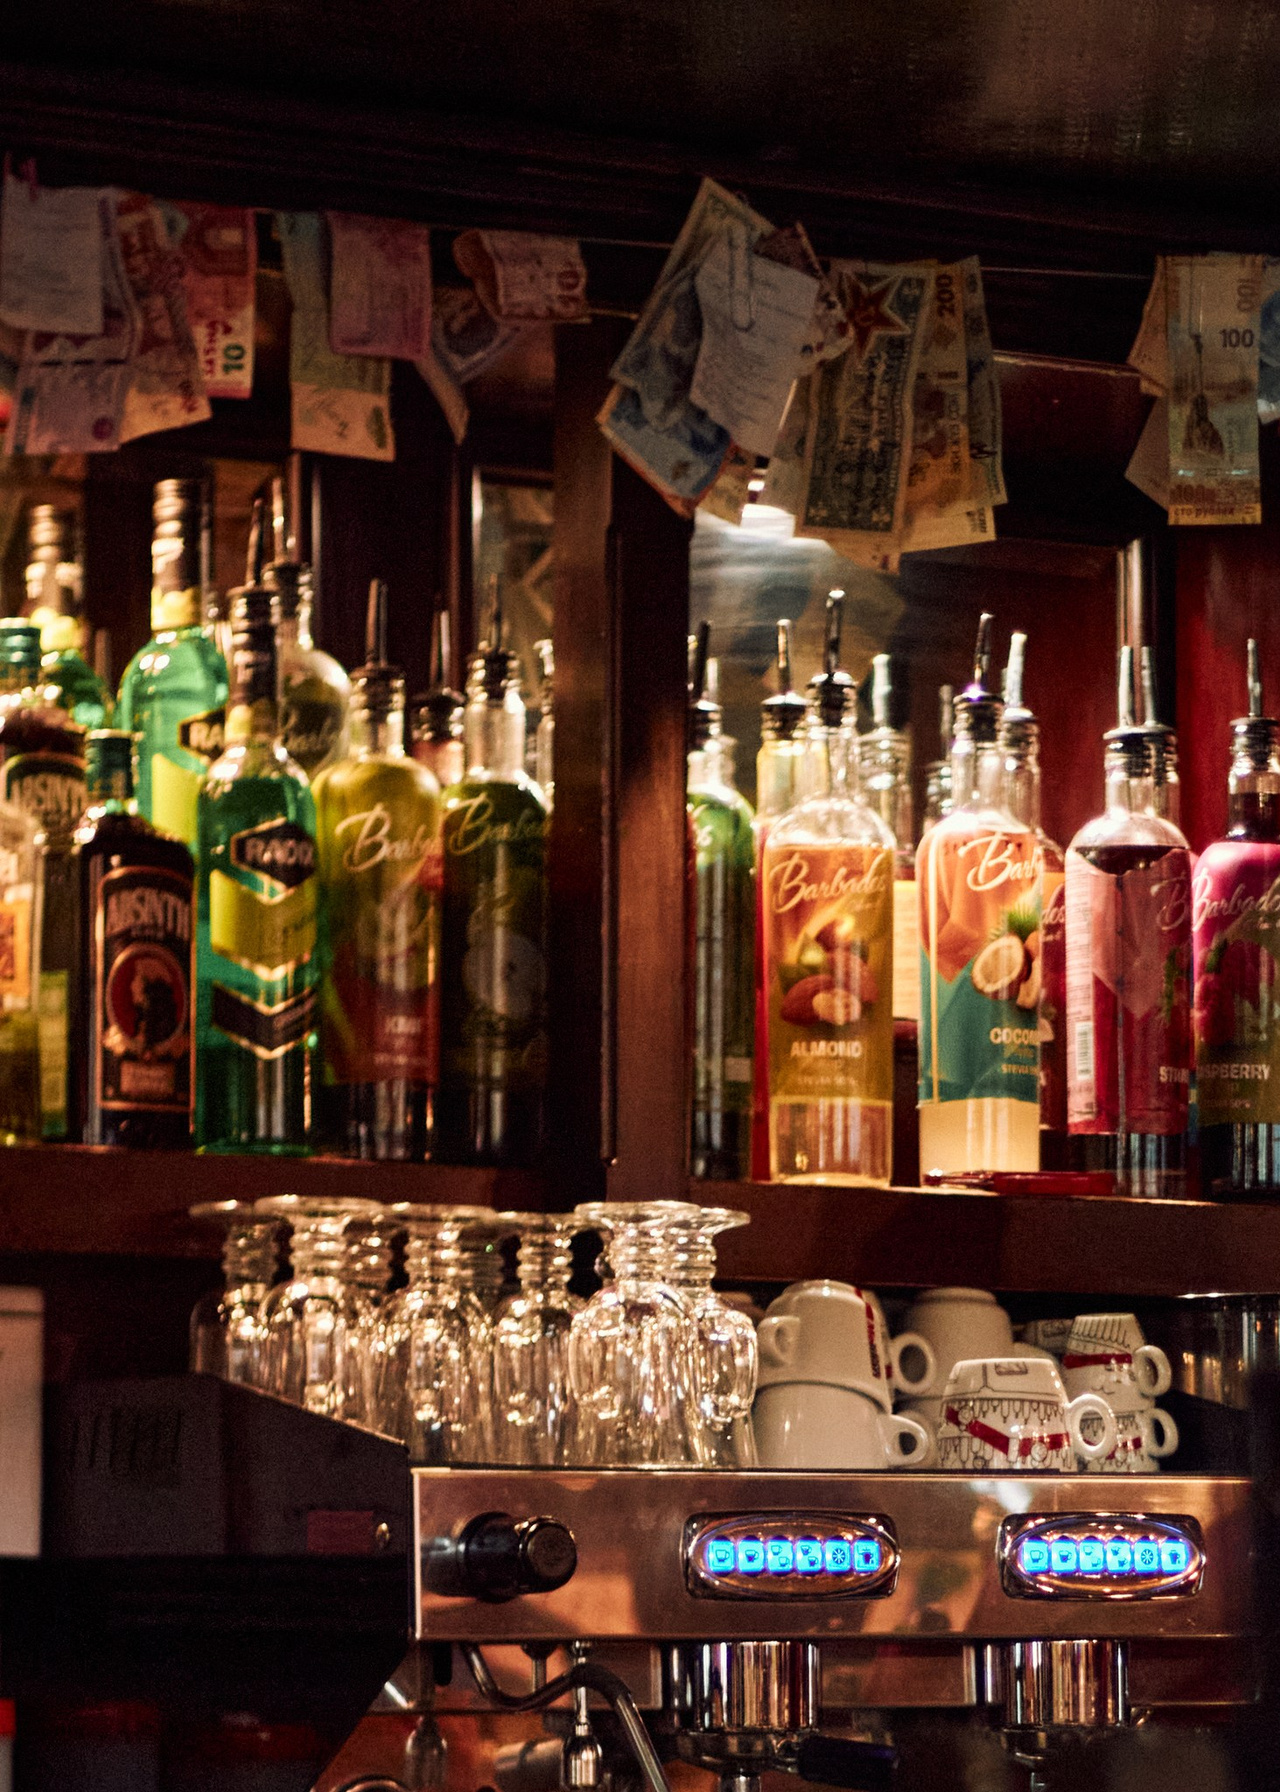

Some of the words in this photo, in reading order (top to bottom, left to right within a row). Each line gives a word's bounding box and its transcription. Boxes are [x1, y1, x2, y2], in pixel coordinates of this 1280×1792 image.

[936, 273, 957, 318] 200
[1220, 328, 1255, 348] 100
[222, 344, 246, 374] 10
[769, 852, 886, 913] Barbados
[790, 1041, 862, 1058] ALMOND
